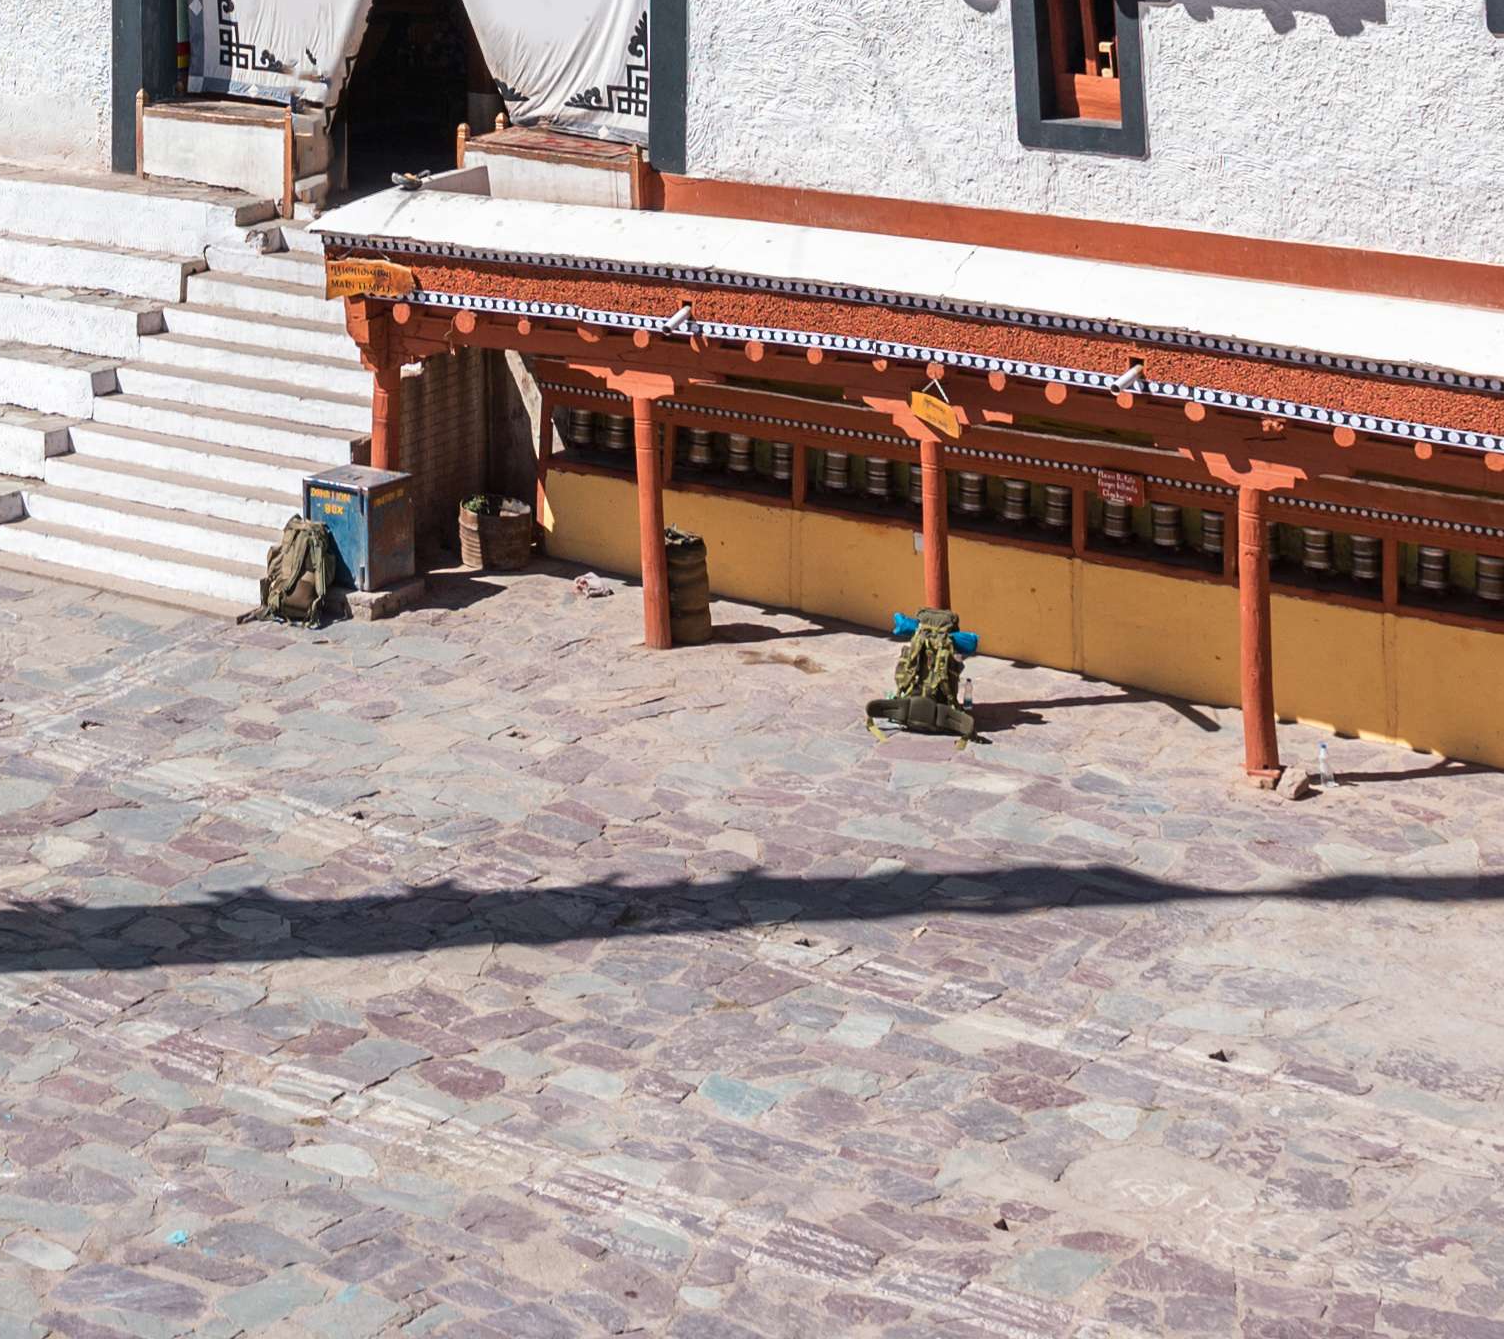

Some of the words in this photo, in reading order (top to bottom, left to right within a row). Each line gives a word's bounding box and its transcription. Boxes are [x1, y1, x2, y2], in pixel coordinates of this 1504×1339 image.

[331, 279, 355, 289] MAIN
[358, 282, 392, 293] TEMPLE
[324, 503, 344, 515] BOX
